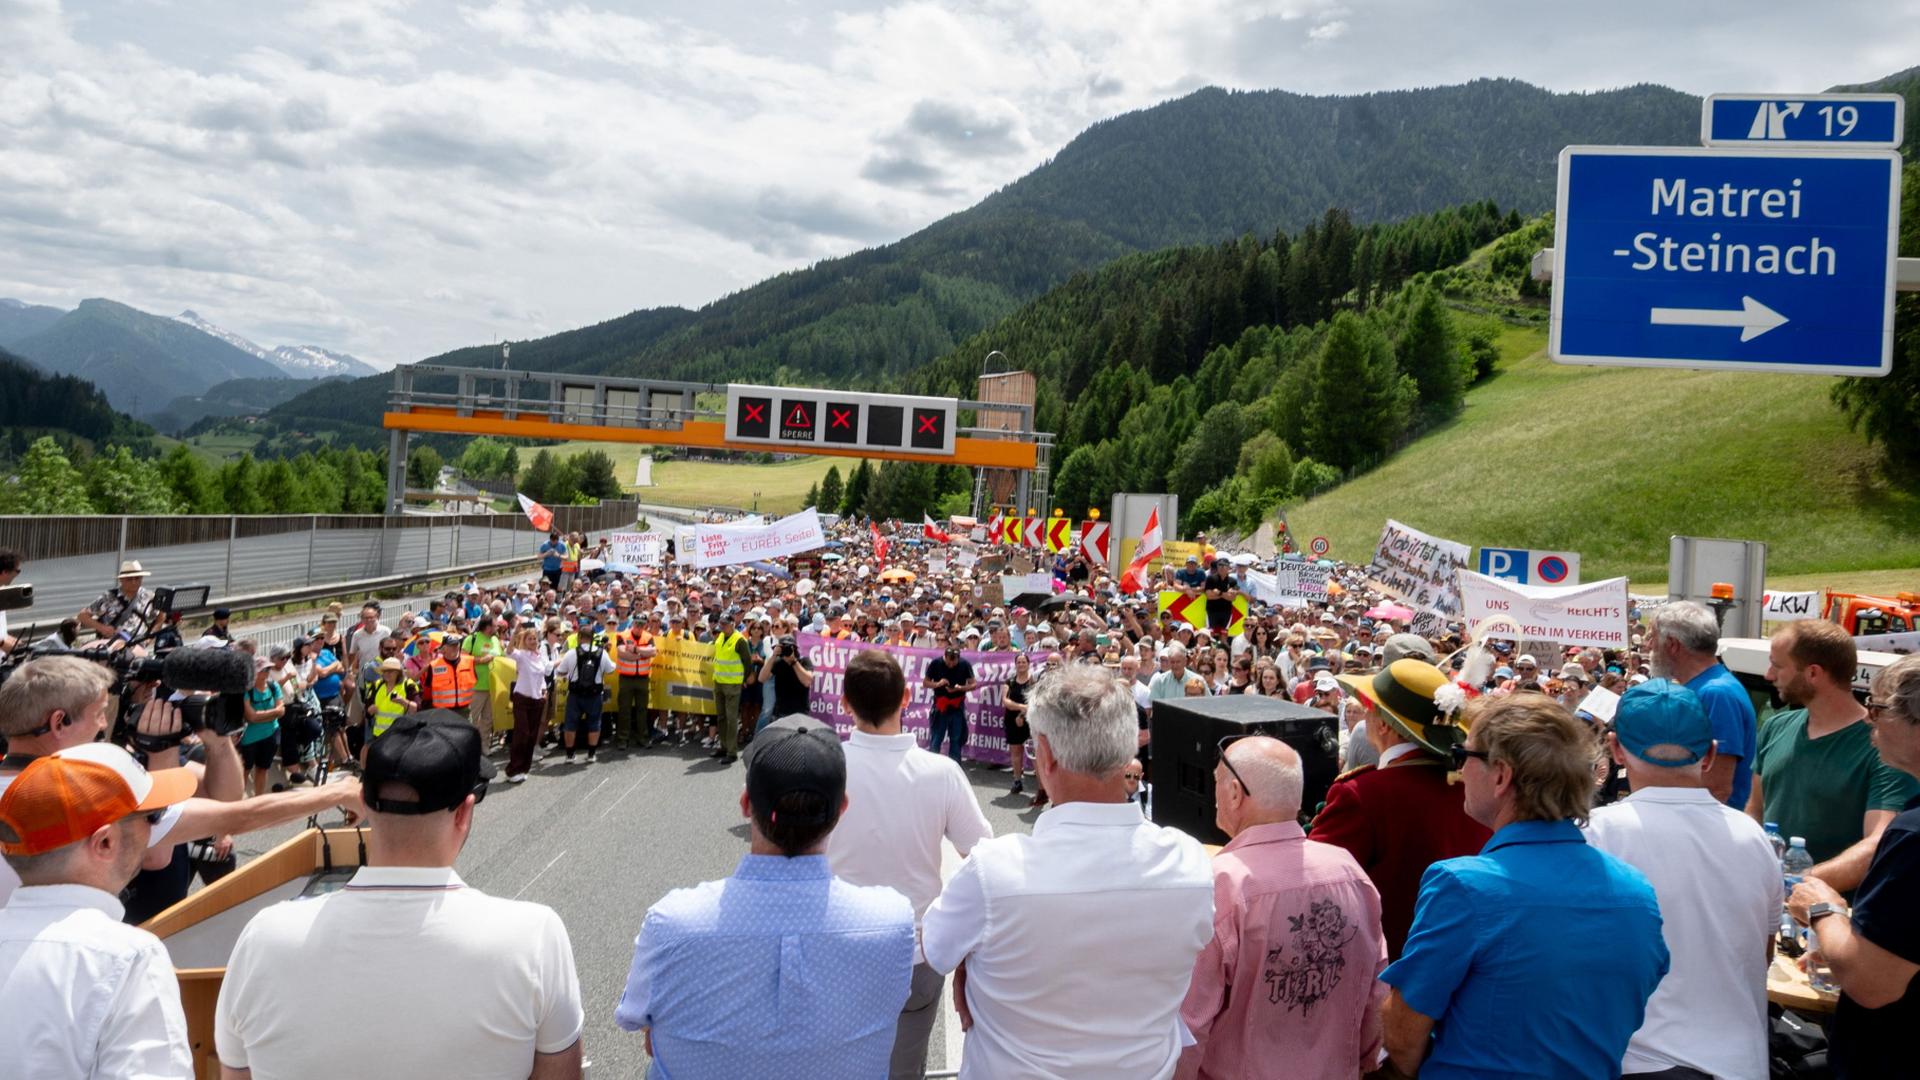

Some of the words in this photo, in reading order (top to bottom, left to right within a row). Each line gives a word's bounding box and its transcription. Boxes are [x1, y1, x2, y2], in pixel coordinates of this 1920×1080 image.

[1817, 105, 1859, 137] 19
[1651, 178, 1803, 219] Matrei
[1613, 232, 1837, 276] -Steinach
[781, 429, 813, 440] SPERRE
[701, 533, 723, 544] Liste
[741, 538, 780, 553] EURER
[784, 527, 816, 545] Seite!
[1381, 526, 1440, 561] Mobilität
[625, 543, 647, 553] STATT
[1314, 541, 1326, 551] 60
[621, 553, 654, 563] TRANSIT
[704, 548, 726, 559] Tirol
[1280, 562, 1330, 573] DEUTSCHLAND
[1296, 583, 1324, 593] TIROL
[1281, 589, 1328, 600] ERSTICKT!
[1485, 599, 1510, 611] UNS
[1769, 595, 1810, 614] LKW
[1549, 627, 1564, 639] IM
[1567, 630, 1622, 642] VERKEHR
